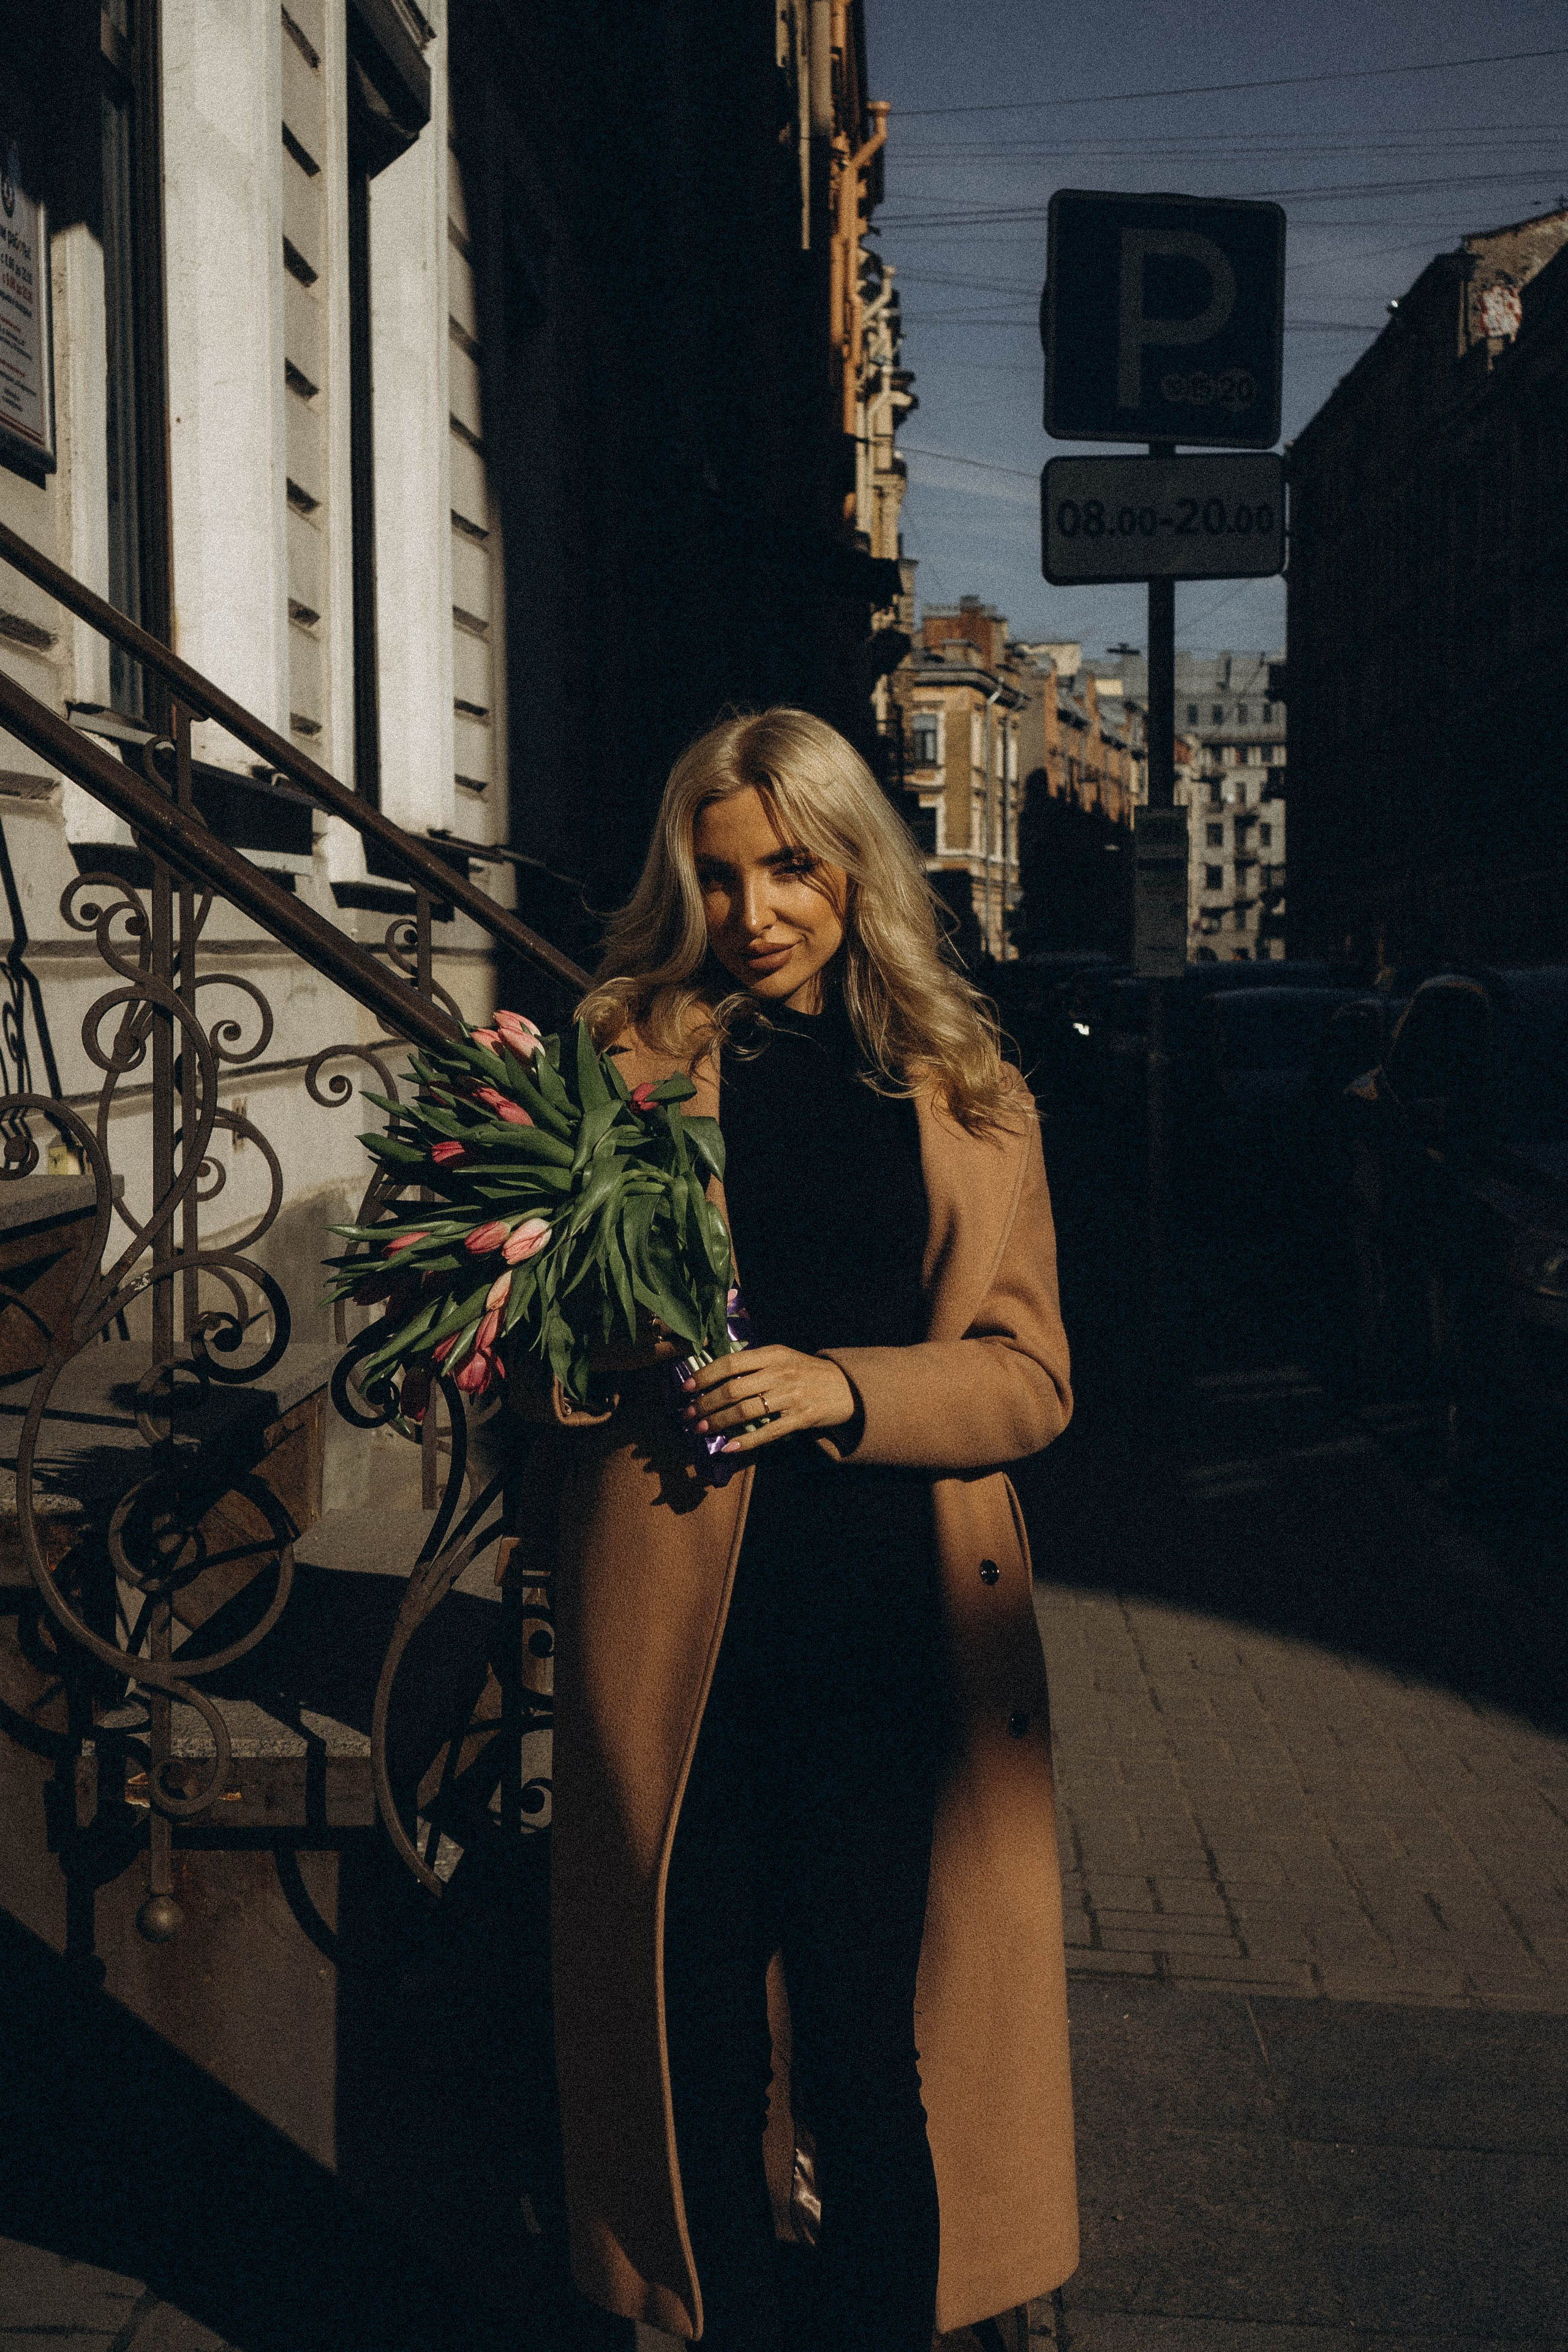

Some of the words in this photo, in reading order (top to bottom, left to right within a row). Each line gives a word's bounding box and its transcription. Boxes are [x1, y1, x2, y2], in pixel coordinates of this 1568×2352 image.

[1118, 227, 1237, 409] P
[1218, 377, 1253, 402] 20
[1057, 497, 1275, 538] 08.00-20.00
